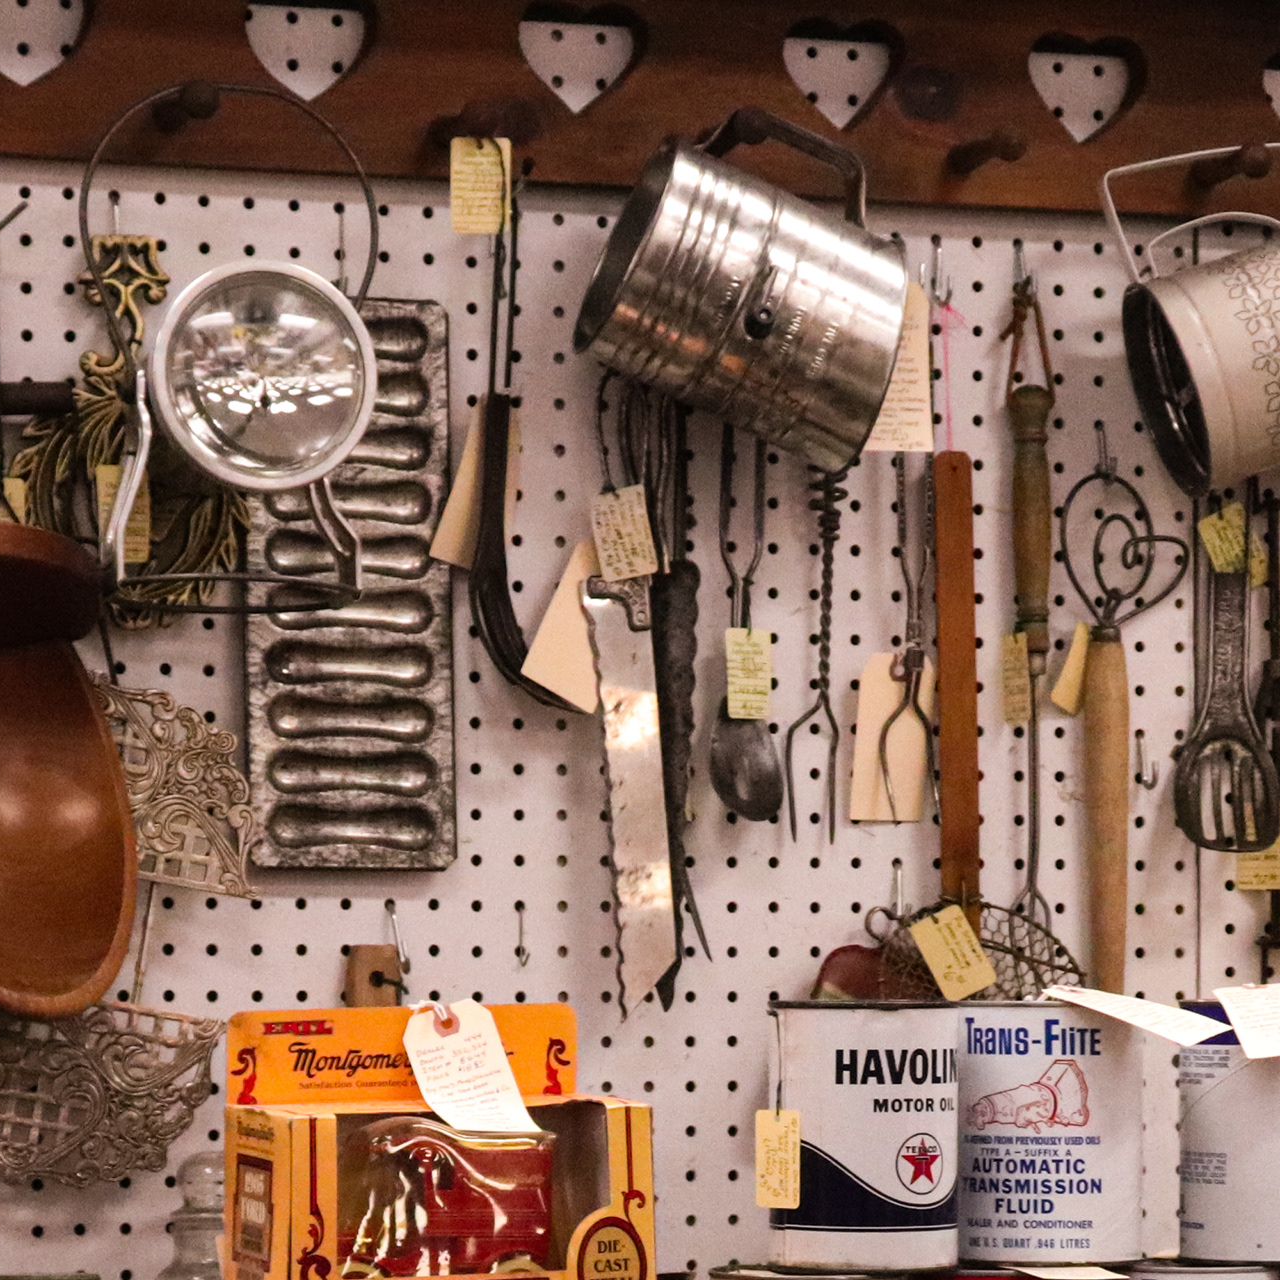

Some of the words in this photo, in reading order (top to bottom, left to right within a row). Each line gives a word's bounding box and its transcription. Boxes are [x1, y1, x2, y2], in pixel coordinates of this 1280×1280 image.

[299, 1079, 352, 1090] Satisfaction
[356, 1078, 409, 1088] Guaranteed
[873, 1098, 934, 1113] MOTOR
[939, 1097, 955, 1112] OIL
[1015, 1136, 1062, 1145] PREVIOUSLY
[1064, 1137, 1084, 1145] USED
[981, 1148, 1000, 1157] TYPE
[1004, 1148, 1011, 1156] A
[1025, 1148, 1059, 1157] SUFFIX
[1065, 1149, 1072, 1157] A
[972, 1158, 1086, 1174] AUTOMATIC
[962, 1177, 1103, 1195] TRANSMISSION
[995, 1199, 1055, 1214] FLUID
[997, 1219, 1018, 1229] AND
[1024, 1220, 1093, 1229] CONDITIONER
[597, 1239, 625, 1254] DIE-
[1003, 1239, 1031, 1249] QUART
[1060, 1239, 1090, 1249] LITRES
[593, 1258, 630, 1272] CAST
